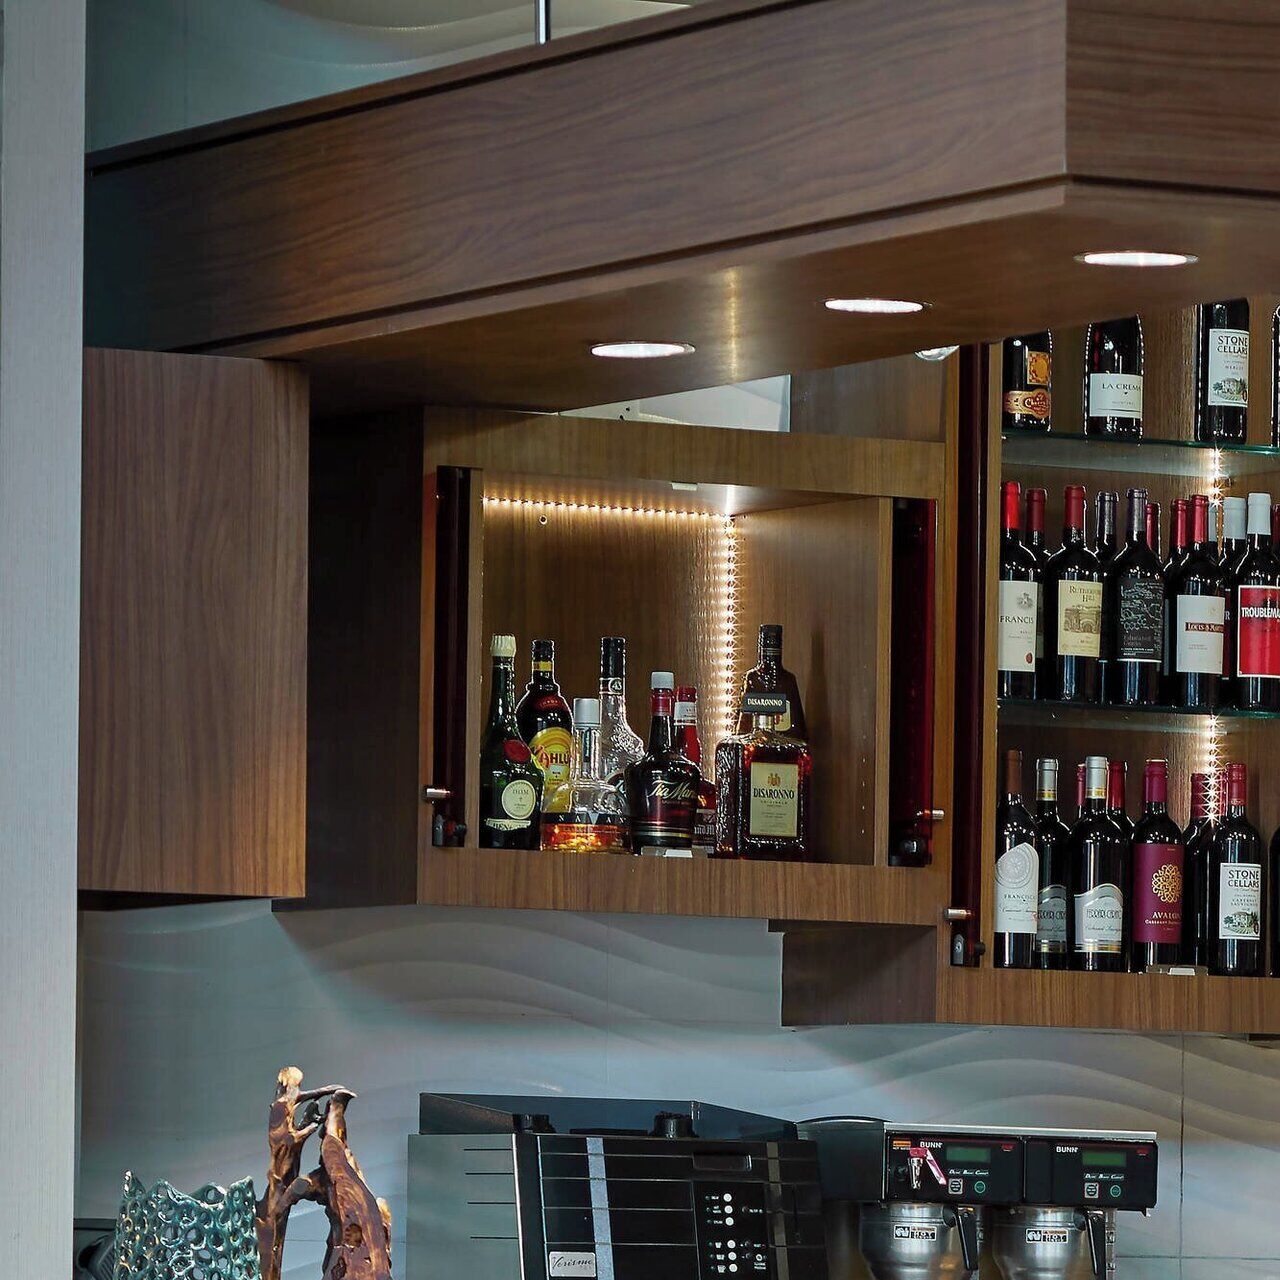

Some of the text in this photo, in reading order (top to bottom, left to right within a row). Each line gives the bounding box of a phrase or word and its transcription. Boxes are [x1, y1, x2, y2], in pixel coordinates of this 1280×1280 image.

[1000, 615, 1034, 625] FRANCIS
[747, 698, 783, 707] DISARONNO
[753, 788, 795, 799] DISARONNO
[1228, 869, 1259, 880] STONE
[1228, 879, 1260, 888] CELLARS
[919, 1141, 943, 1149] BUNN
